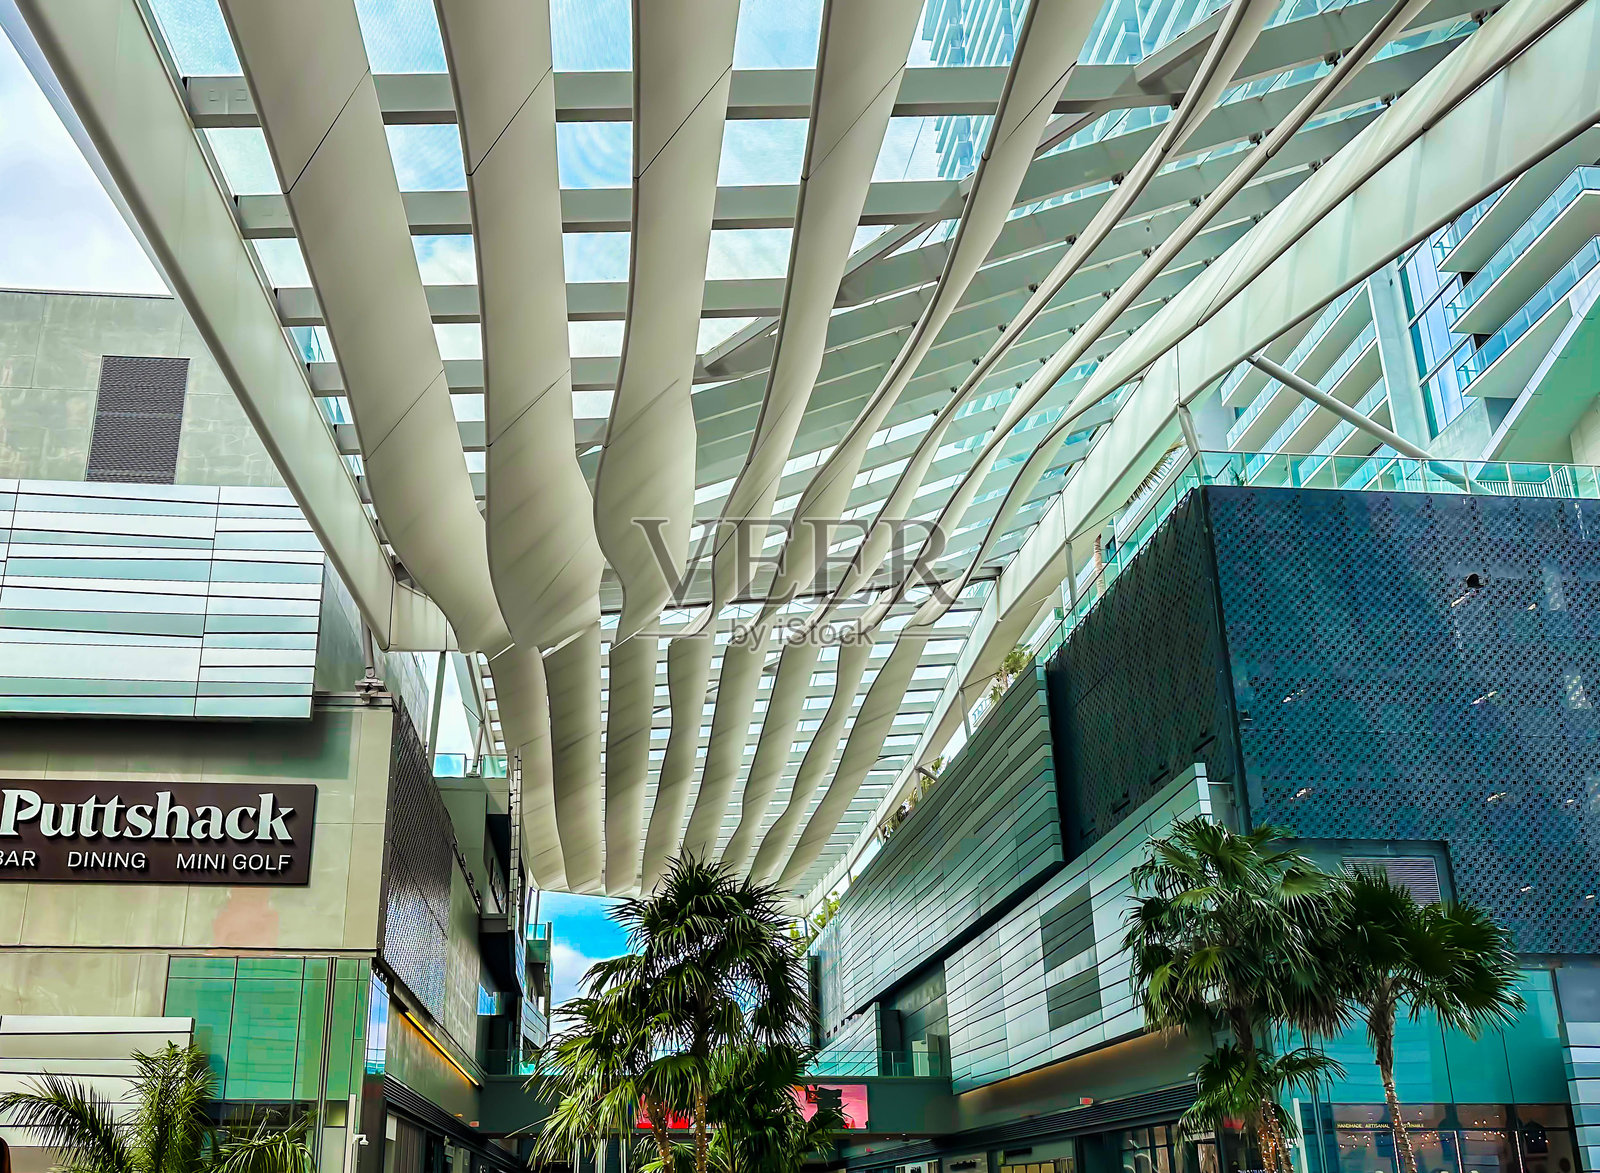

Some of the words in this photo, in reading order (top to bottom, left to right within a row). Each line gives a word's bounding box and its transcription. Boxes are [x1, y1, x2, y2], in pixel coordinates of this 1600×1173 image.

[0, 789, 295, 840] Puttshack
[67, 851, 146, 869] DINING
[176, 853, 226, 870] MINI
[232, 853, 291, 871] GOLF
